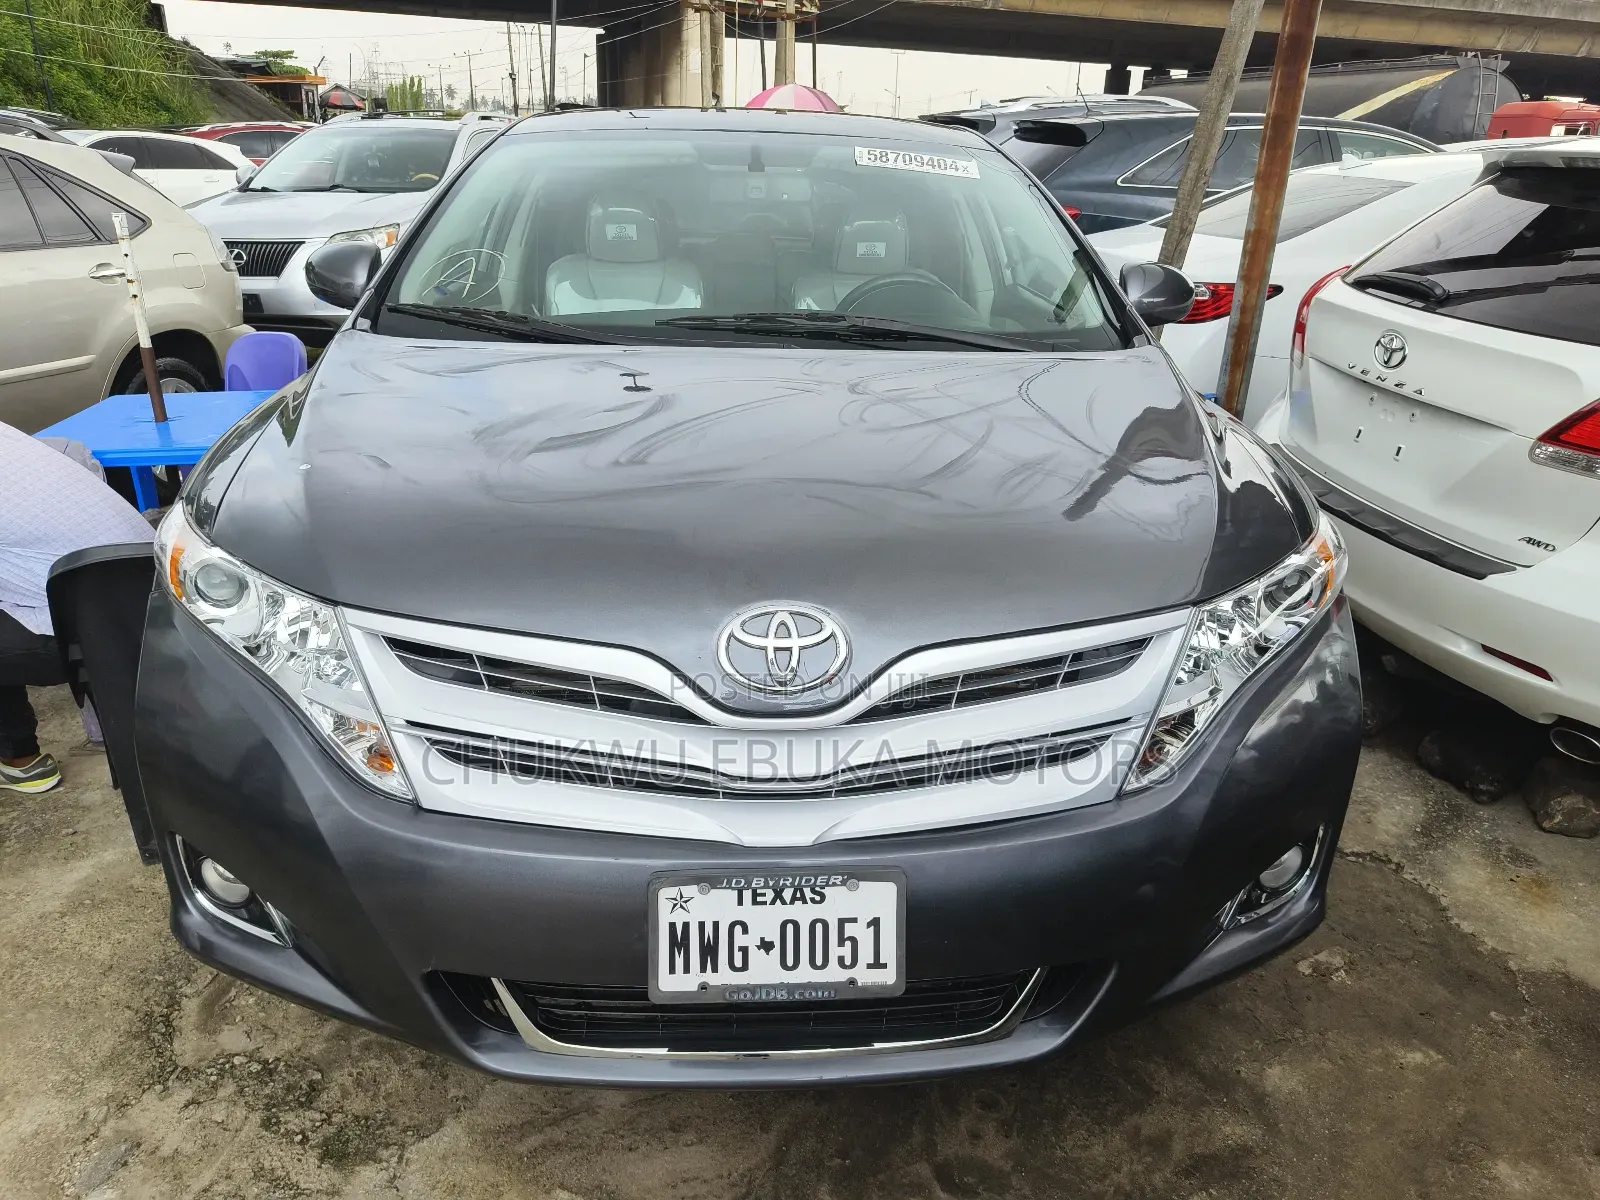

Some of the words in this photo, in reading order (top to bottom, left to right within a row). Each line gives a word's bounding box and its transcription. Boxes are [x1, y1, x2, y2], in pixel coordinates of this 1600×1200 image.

[1348, 362, 1425, 396] VENZA
[1518, 535, 1558, 553] AWD
[731, 886, 827, 906] TEXAS
[668, 919, 750, 975] MWG
[779, 916, 888, 972] 0051
